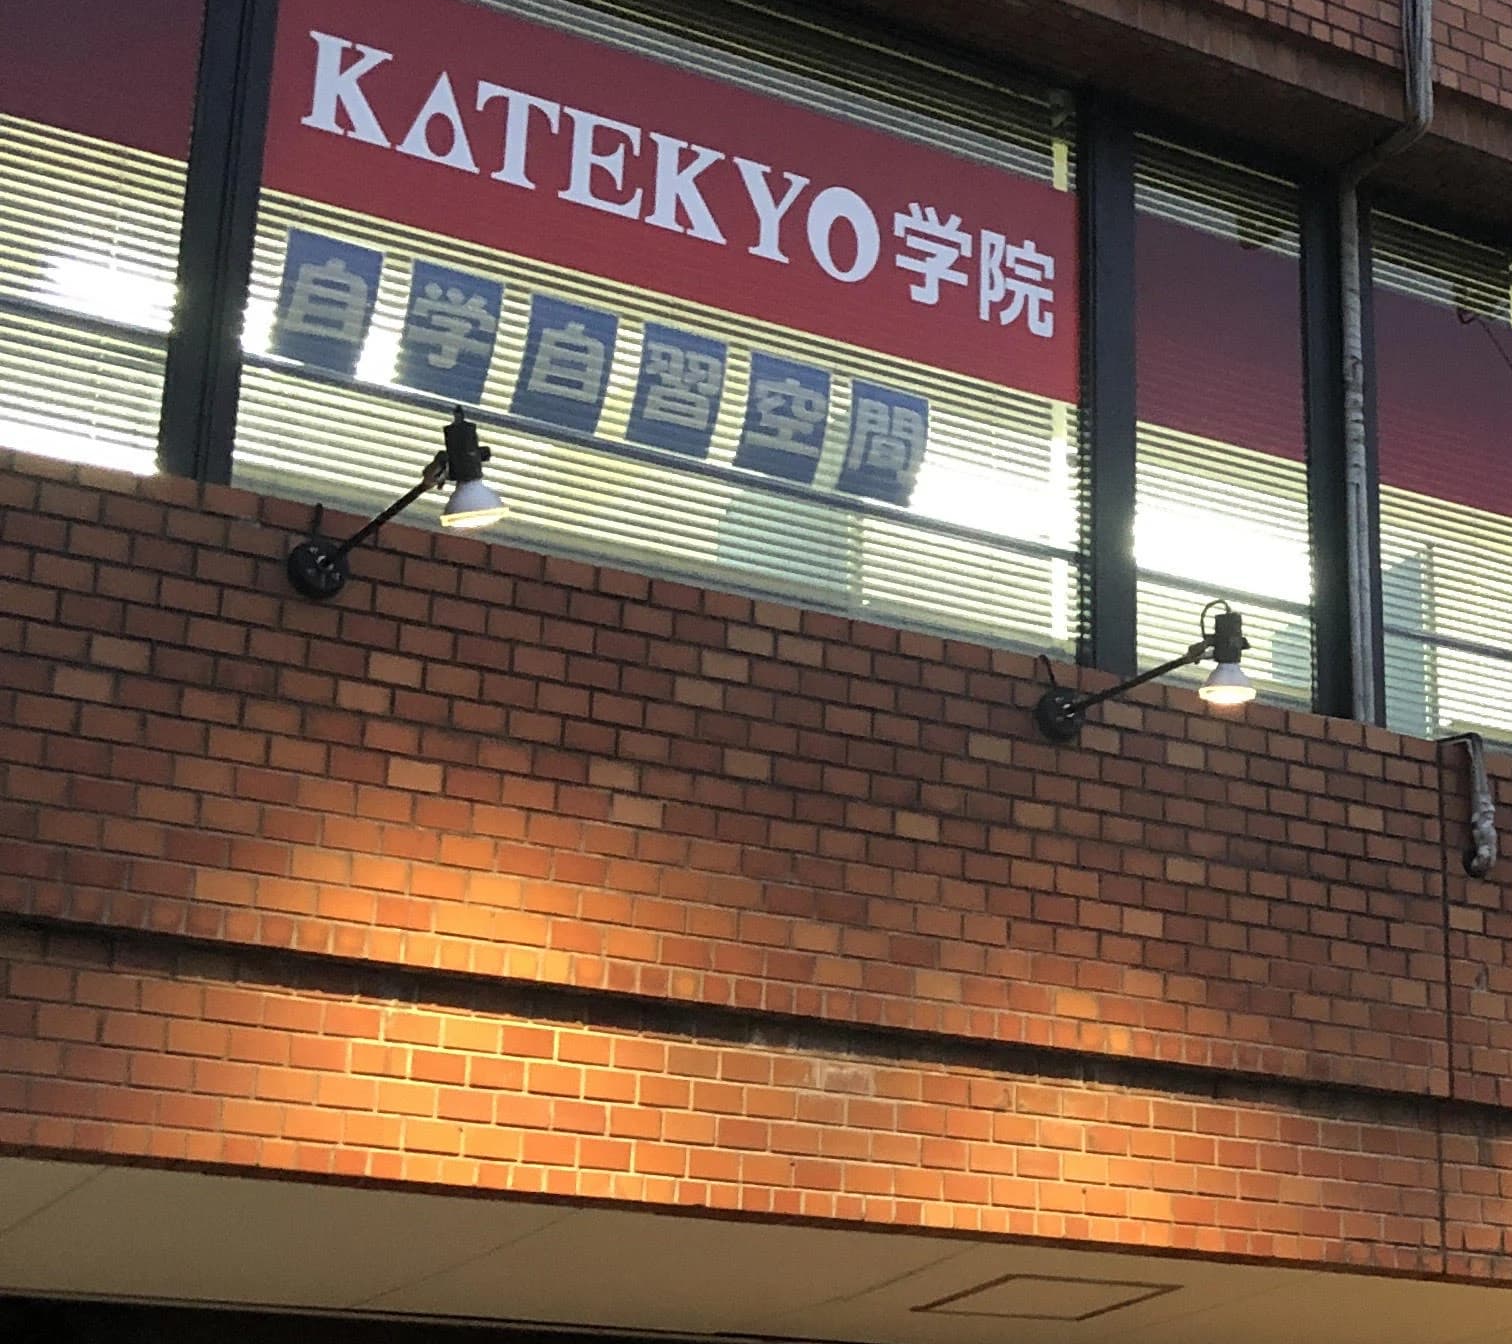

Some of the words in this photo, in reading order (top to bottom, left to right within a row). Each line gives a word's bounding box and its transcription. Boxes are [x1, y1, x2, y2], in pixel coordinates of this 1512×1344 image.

[291, 258, 926, 476] 自学自習空間
